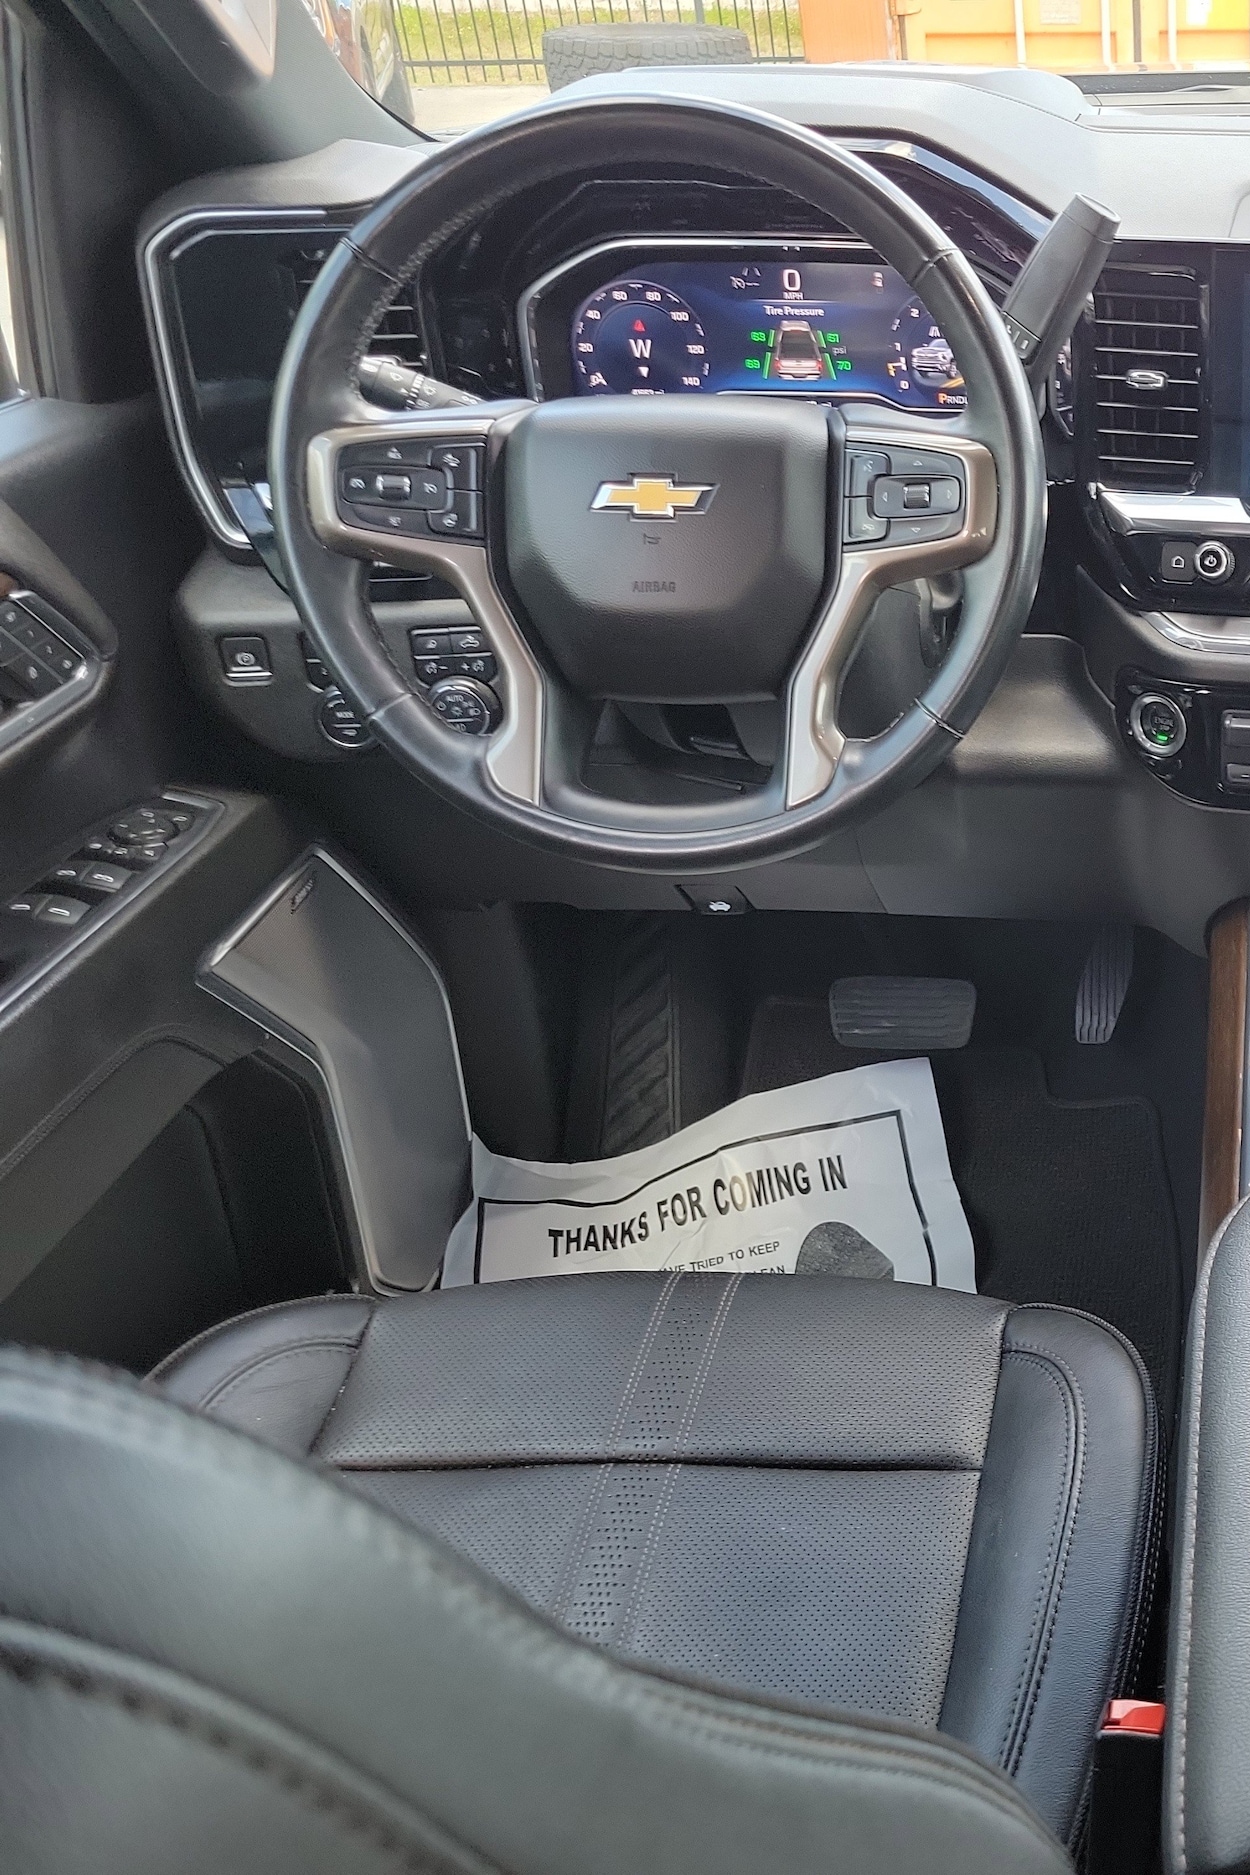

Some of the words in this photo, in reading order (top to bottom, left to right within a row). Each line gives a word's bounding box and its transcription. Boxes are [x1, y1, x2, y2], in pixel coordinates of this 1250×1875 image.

[783, 269, 800, 291] 0
[783, 292, 804, 300] MPH
[585, 309, 601, 320] 40
[670, 311, 689, 321] 100
[763, 305, 783, 316] Tire
[784, 306, 825, 316] Pressure
[577, 342, 594, 353] 20
[628, 338, 652, 359] W
[686, 344, 705, 355] 120
[832, 345, 847, 356] psi
[681, 376, 701, 387] 140
[632, 580, 677, 592] AIRBAG
[548, 1211, 650, 1258] THANKS
[657, 1186, 707, 1232] FOR
[713, 1162, 812, 1216] COMING
[818, 1155, 848, 1192] IN
[689, 1256, 724, 1273] TRIED
[728, 1249, 745, 1261] TO
[749, 1241, 780, 1257] KEEP
